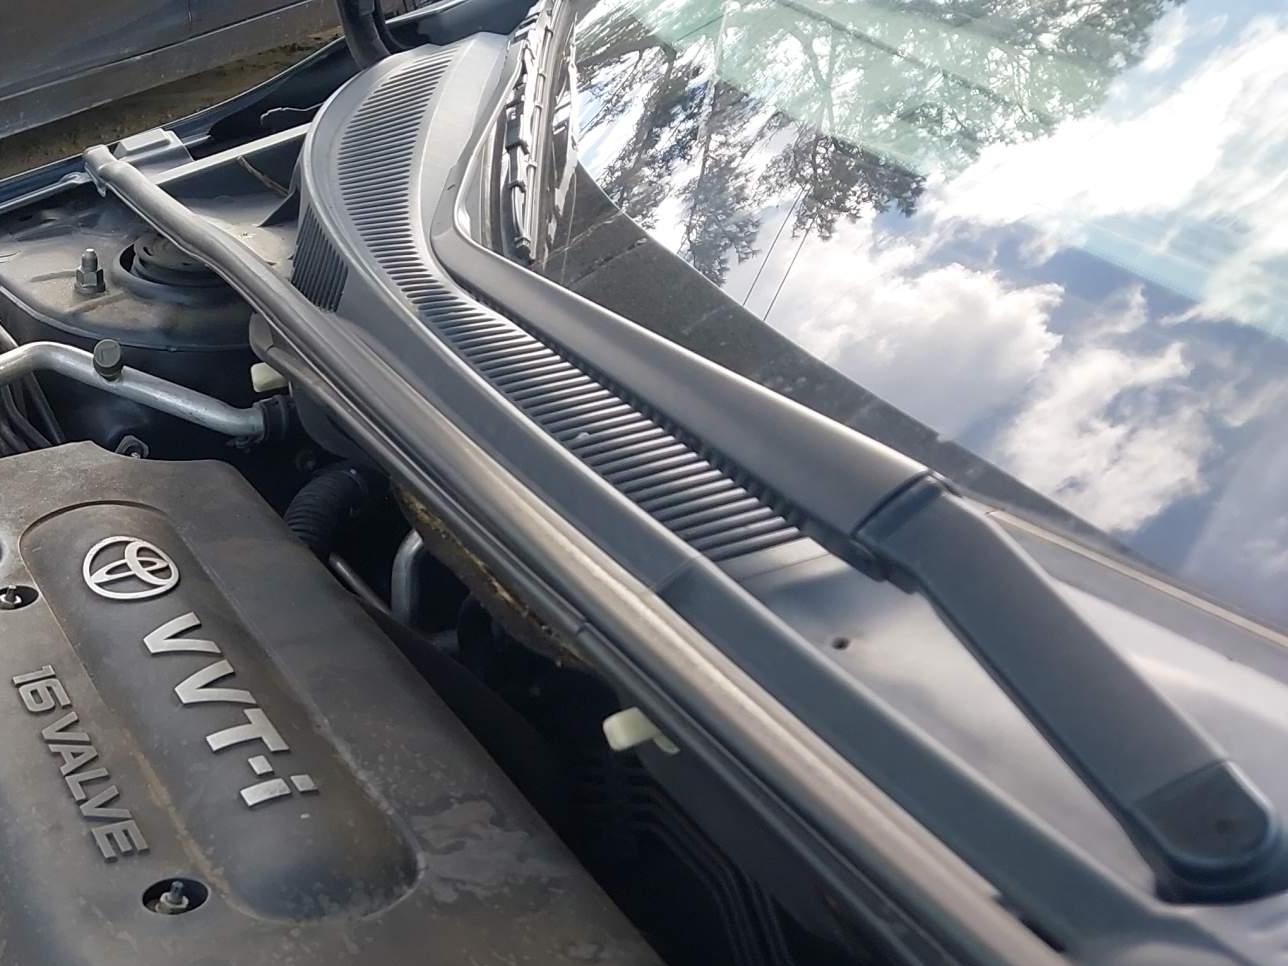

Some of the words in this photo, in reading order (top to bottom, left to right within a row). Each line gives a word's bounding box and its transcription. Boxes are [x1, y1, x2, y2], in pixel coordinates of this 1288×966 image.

[12, 664, 71, 711] 16
[143, 612, 319, 808] VVT-i
[40, 711, 148, 863] VALVE
